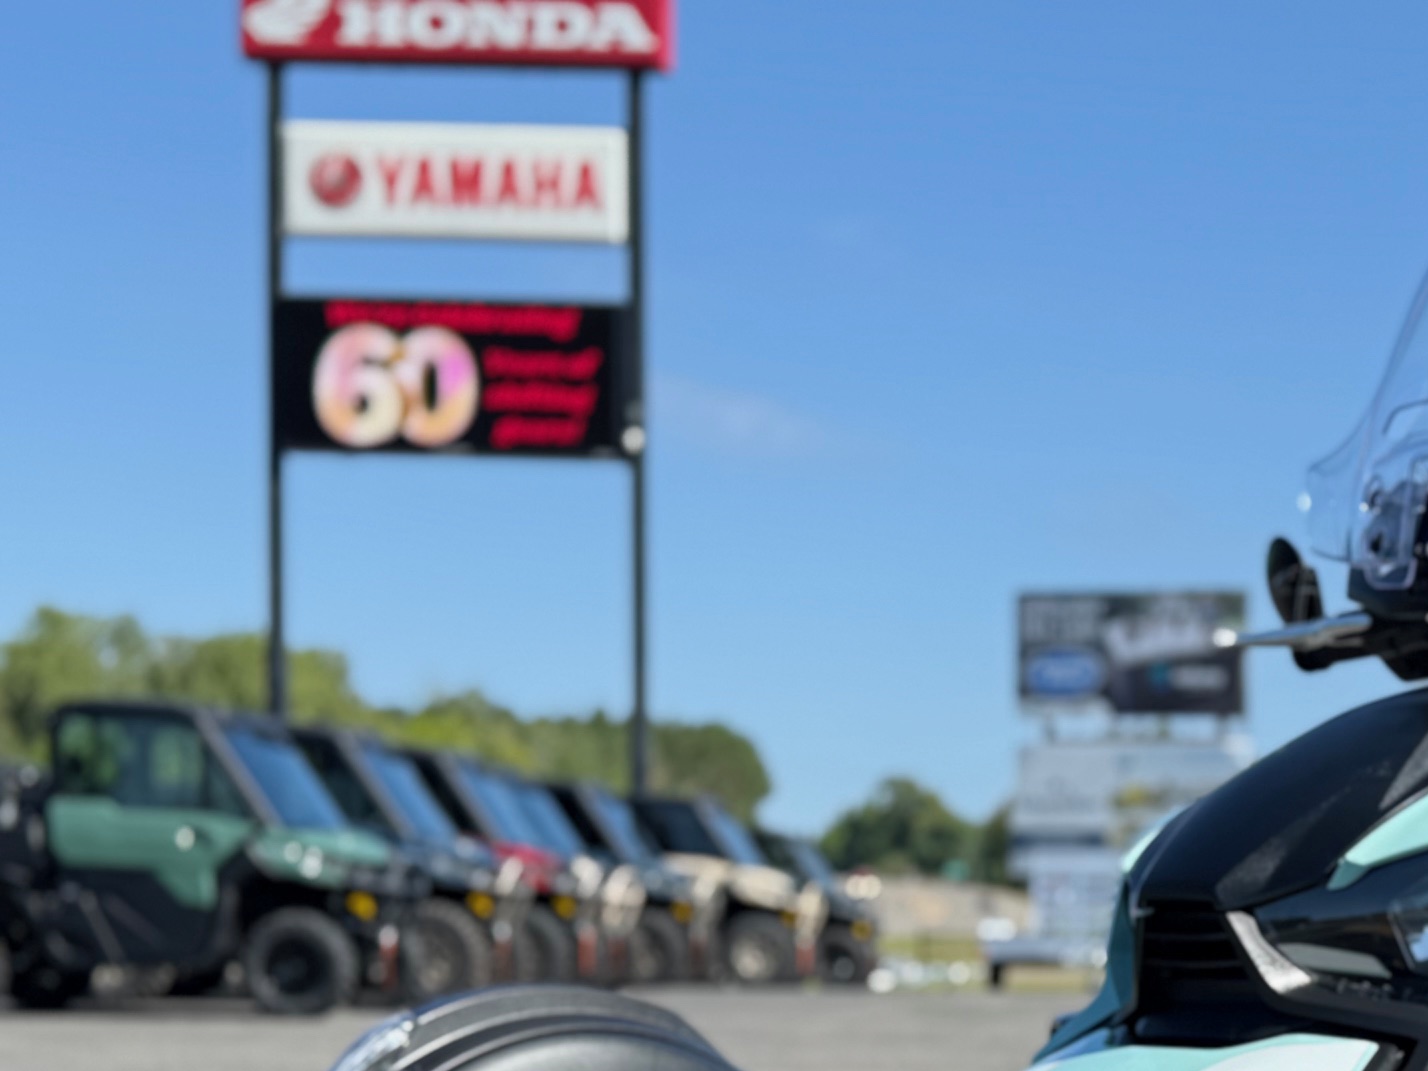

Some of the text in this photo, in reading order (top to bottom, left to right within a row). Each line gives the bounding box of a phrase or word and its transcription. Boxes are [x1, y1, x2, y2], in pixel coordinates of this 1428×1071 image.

[336, 0, 660, 53] HONDA
[378, 156, 602, 211] YAMAHA
[312, 321, 480, 448] 60
